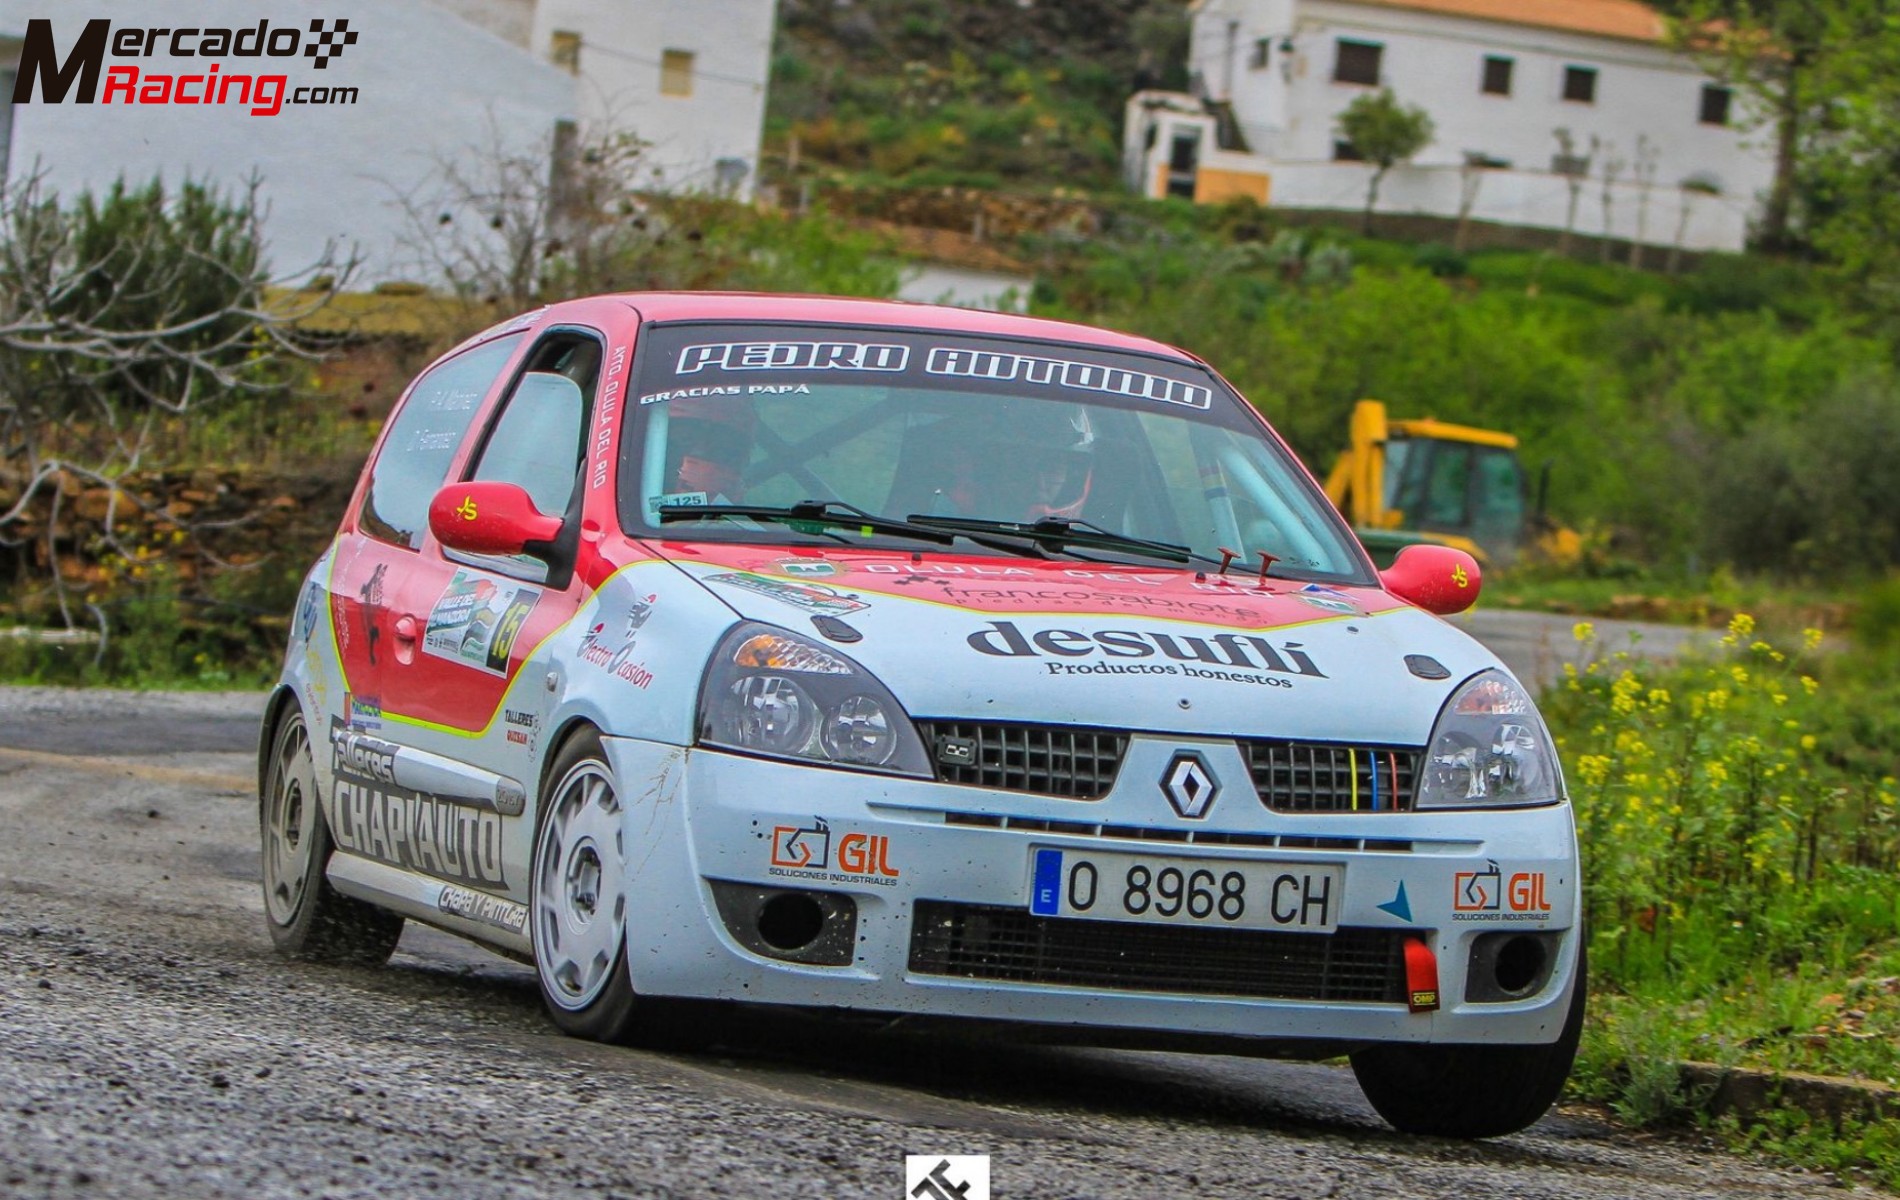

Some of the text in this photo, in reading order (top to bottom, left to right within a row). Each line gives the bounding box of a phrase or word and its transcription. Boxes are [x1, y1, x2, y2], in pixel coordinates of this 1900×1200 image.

[675, 341, 911, 375] PEDRO
[600, 381, 619, 426] OLULA
[640, 384, 811, 405] GRACIAS PAPÁ
[596, 428, 612, 460] DEL
[593, 460, 608, 489] RIO
[673, 495, 701, 506] 125
[865, 564, 1033, 576] OLULA
[1064, 569, 1162, 586] DEL
[492, 602, 530, 659] 15
[1045, 661, 1294, 689] Productos honestos
[838, 833, 899, 877] GIL
[769, 868, 898, 887] SOLUCIONES INDUSTRIALES
[1508, 872, 1551, 911] GIL
[473, 894, 485, 915] Y
[1040, 889, 1052, 903] E
[1123, 864, 1246, 921] 8968
[1270, 873, 1331, 926] CH
[1452, 913, 1550, 921] SOLUCIONES INDUSTRIALES
